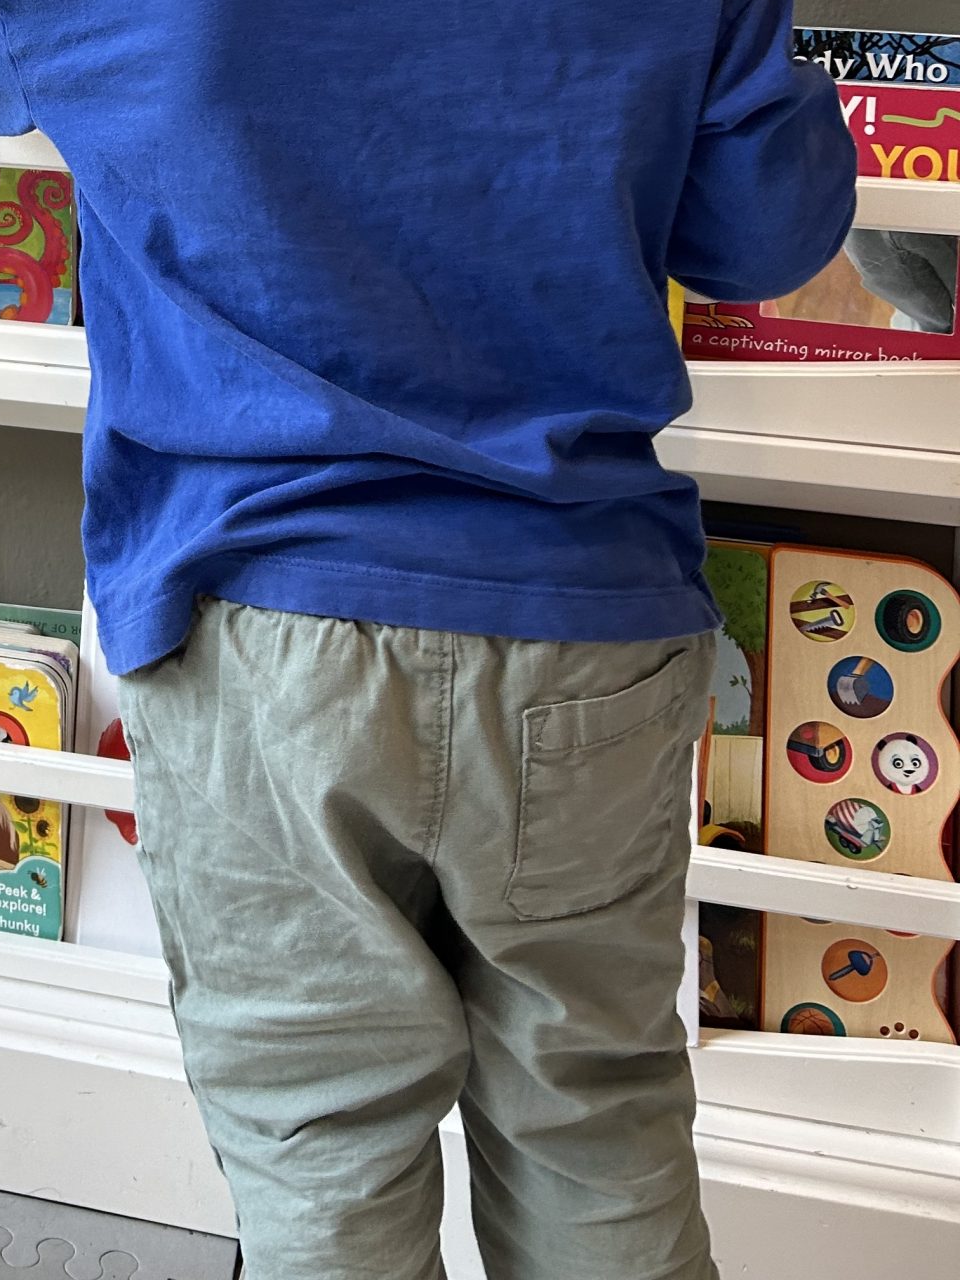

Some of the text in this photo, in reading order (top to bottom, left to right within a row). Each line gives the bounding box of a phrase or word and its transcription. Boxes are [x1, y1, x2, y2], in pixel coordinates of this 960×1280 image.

[866, 52, 948, 82] Who
[870, 143, 960, 182] YO
[692, 334, 702, 344] a
[709, 334, 808, 360] captivating
[814, 344, 873, 361] mirror
[31, 888, 42, 901] &
